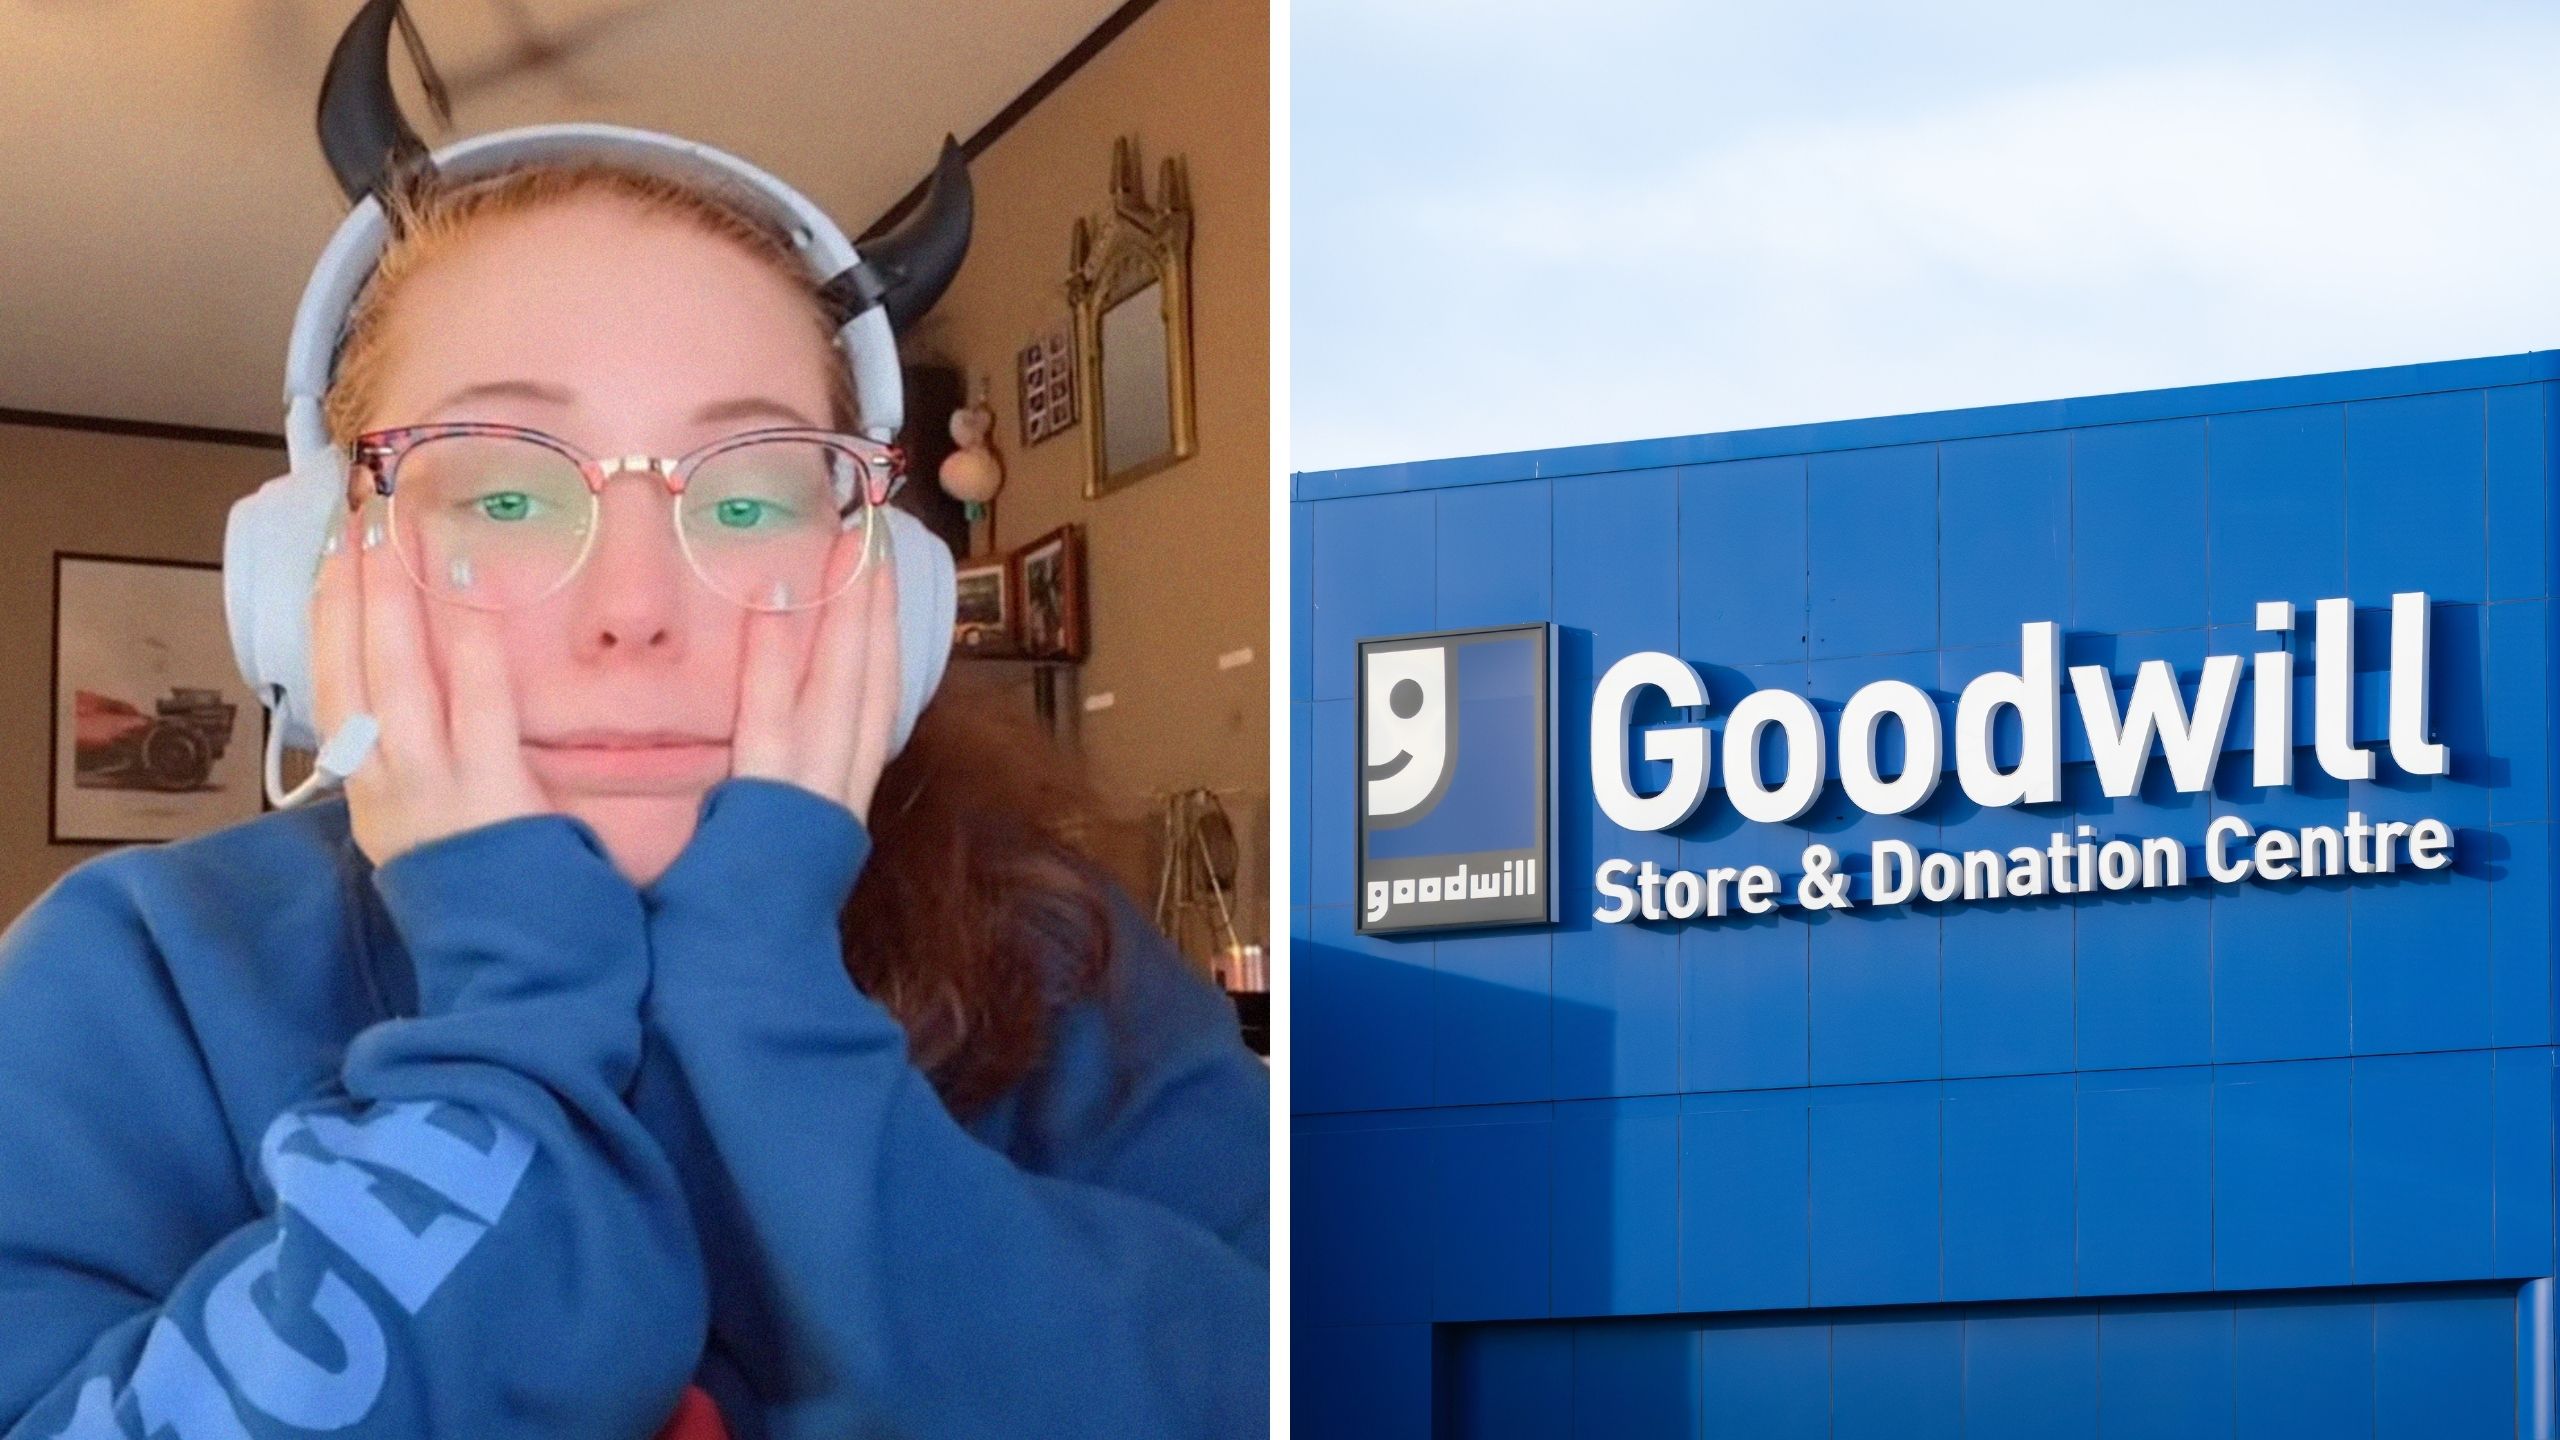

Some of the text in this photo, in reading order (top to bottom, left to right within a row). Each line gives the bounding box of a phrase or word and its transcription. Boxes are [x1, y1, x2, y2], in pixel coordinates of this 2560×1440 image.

[1590, 591, 2450, 832] Goodwill
[1367, 858, 1536, 923] goodwill
[1592, 811, 2451, 924] Store & Donation Centre
